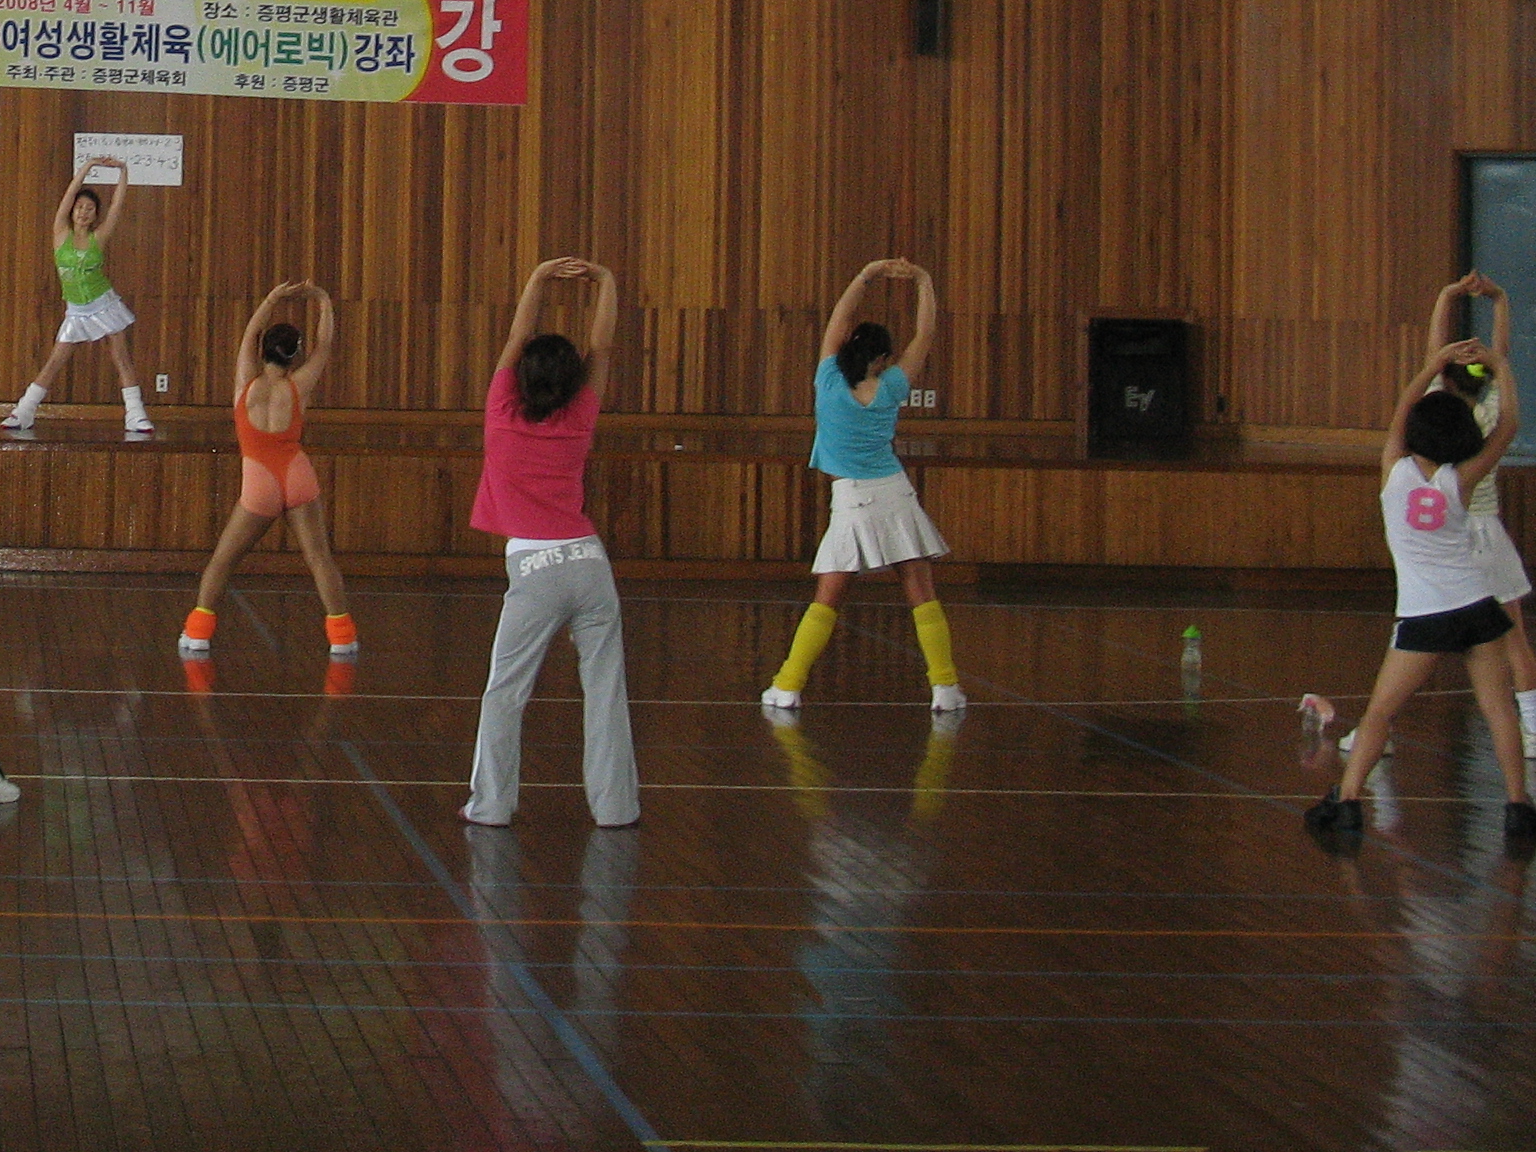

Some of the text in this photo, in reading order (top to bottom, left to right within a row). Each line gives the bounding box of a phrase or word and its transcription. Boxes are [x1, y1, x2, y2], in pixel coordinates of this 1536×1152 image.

[117, 0, 155, 16] 11월
[203, 2, 239, 20] 장소
[256, 4, 399, 27] 증평군생활체육관
[91, 67, 187, 87] 증평군체육회
[233, 74, 266, 91] 후원
[282, 76, 331, 92] 증평군
[1406, 487, 1448, 532] 8
[519, 547, 564, 577] SPORTS
